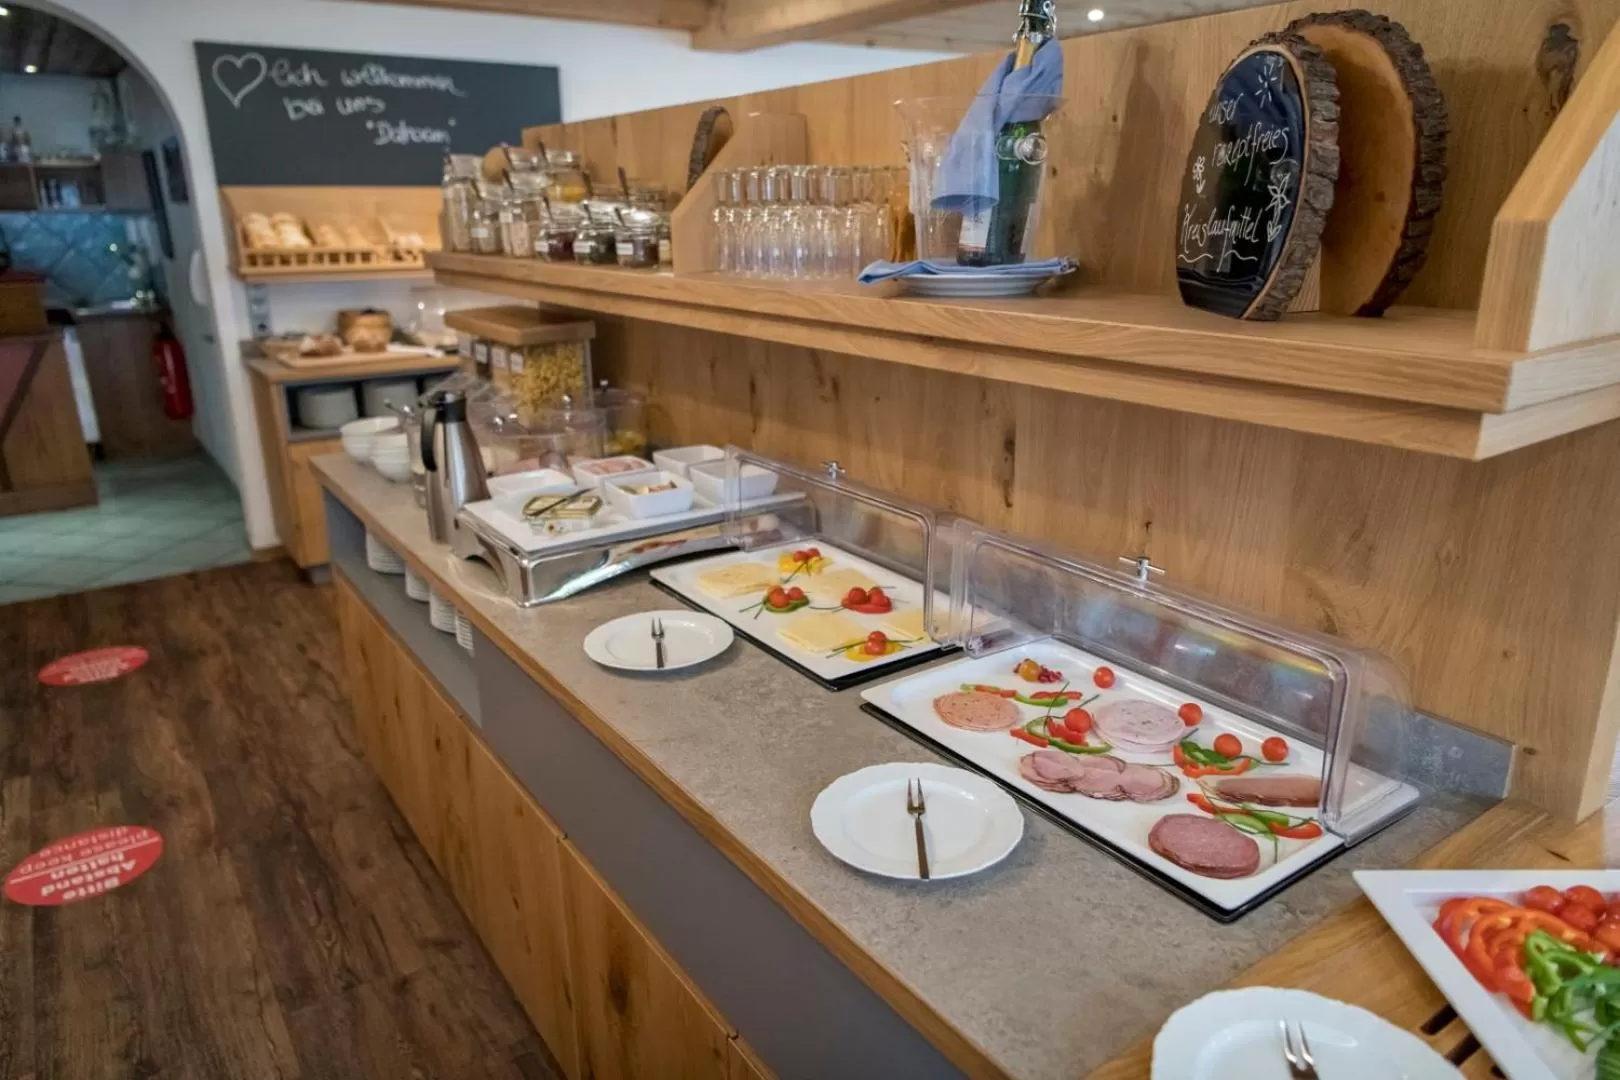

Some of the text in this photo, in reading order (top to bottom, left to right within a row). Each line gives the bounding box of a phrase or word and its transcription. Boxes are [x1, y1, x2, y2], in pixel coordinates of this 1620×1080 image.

[336, 95, 386, 115] uns
[1209, 92, 1245, 125] unser
[1181, 203, 1260, 273] Kreislaufmittel
[41, 859, 137, 897] Abstand
[50, 851, 125, 880] halten
[62, 876, 120, 900] Bitte
